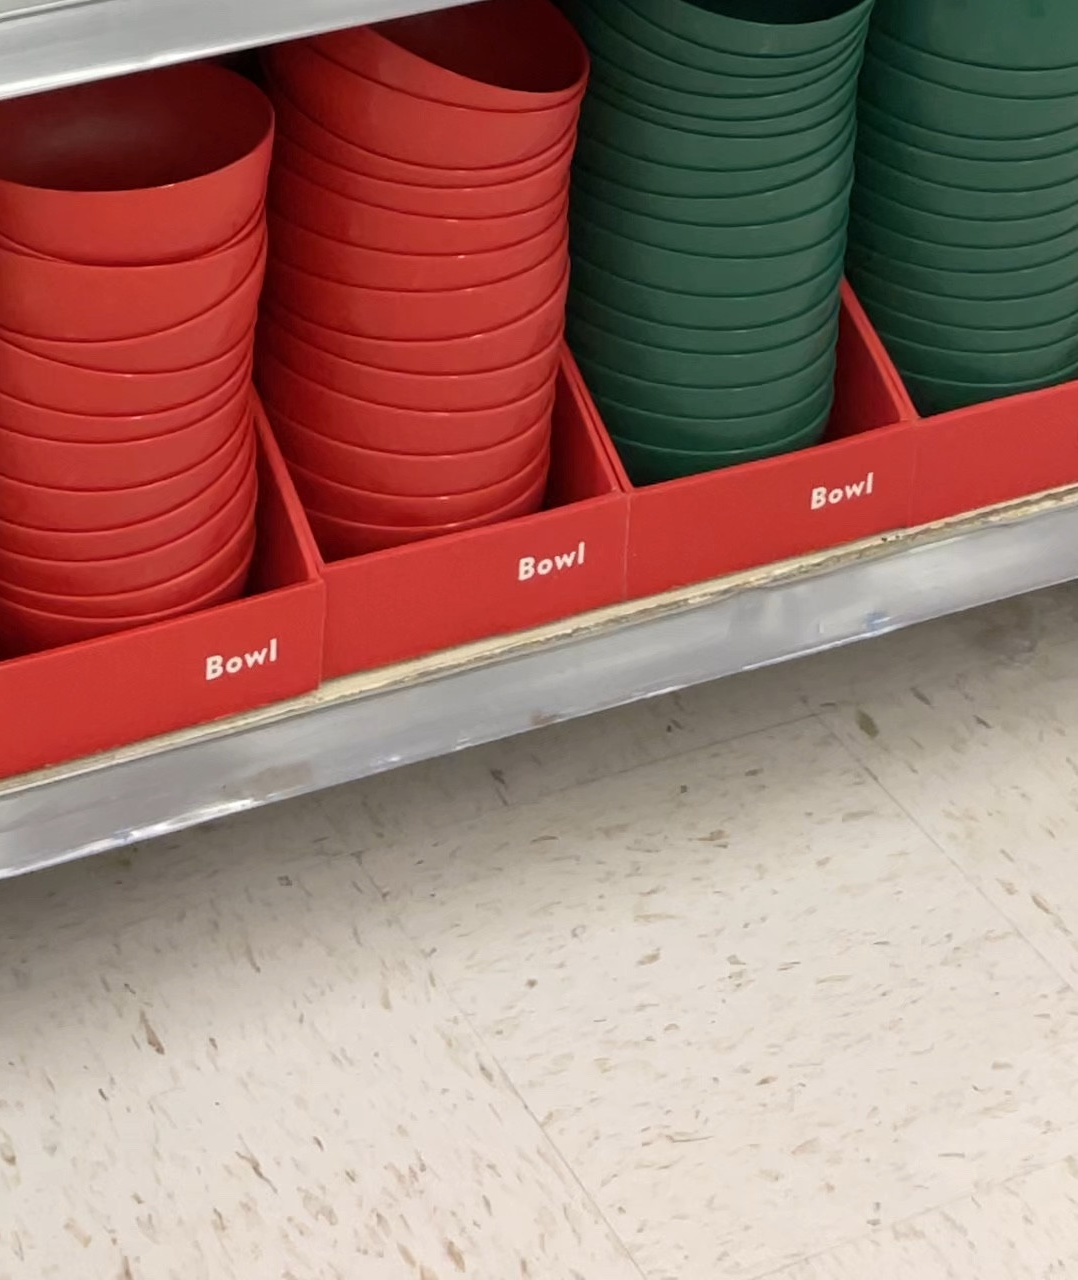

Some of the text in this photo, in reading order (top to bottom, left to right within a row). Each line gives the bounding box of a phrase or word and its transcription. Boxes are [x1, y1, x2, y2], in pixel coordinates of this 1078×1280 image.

[810, 472, 874, 510] Bowl
[518, 541, 585, 581] Bowl
[205, 638, 277, 681] Bowl
